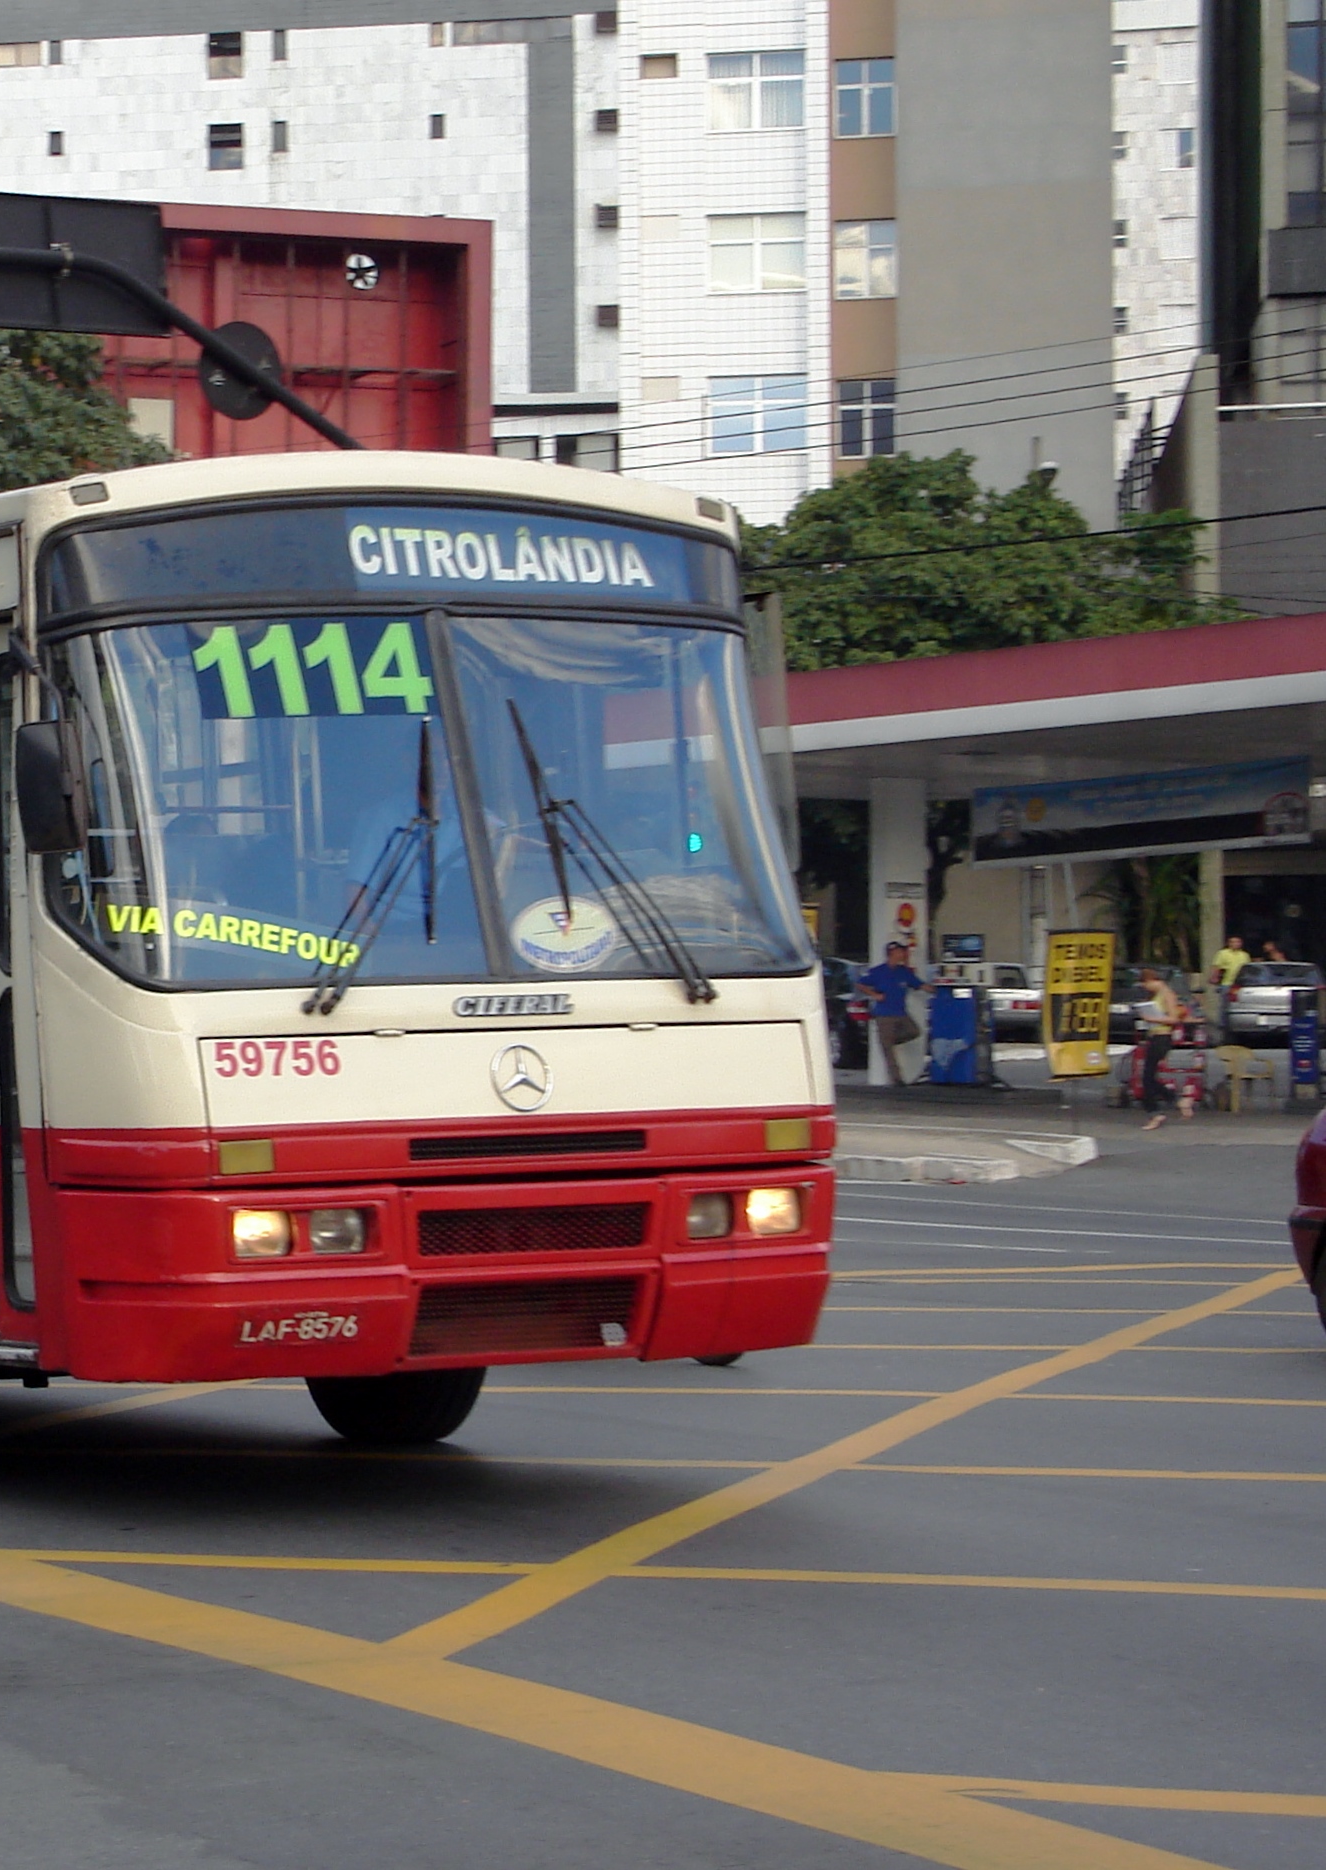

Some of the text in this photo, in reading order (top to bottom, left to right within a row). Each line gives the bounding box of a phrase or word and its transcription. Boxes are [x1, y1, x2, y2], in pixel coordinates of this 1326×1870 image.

[349, 525, 655, 588] CITROLÂNDIA
[193, 622, 434, 717] 1114
[107, 904, 164, 935] VIA
[453, 993, 574, 1017] CIFERAL
[214, 1039, 342, 1077] 59756
[240, 1315, 359, 1342] LAF-8576
